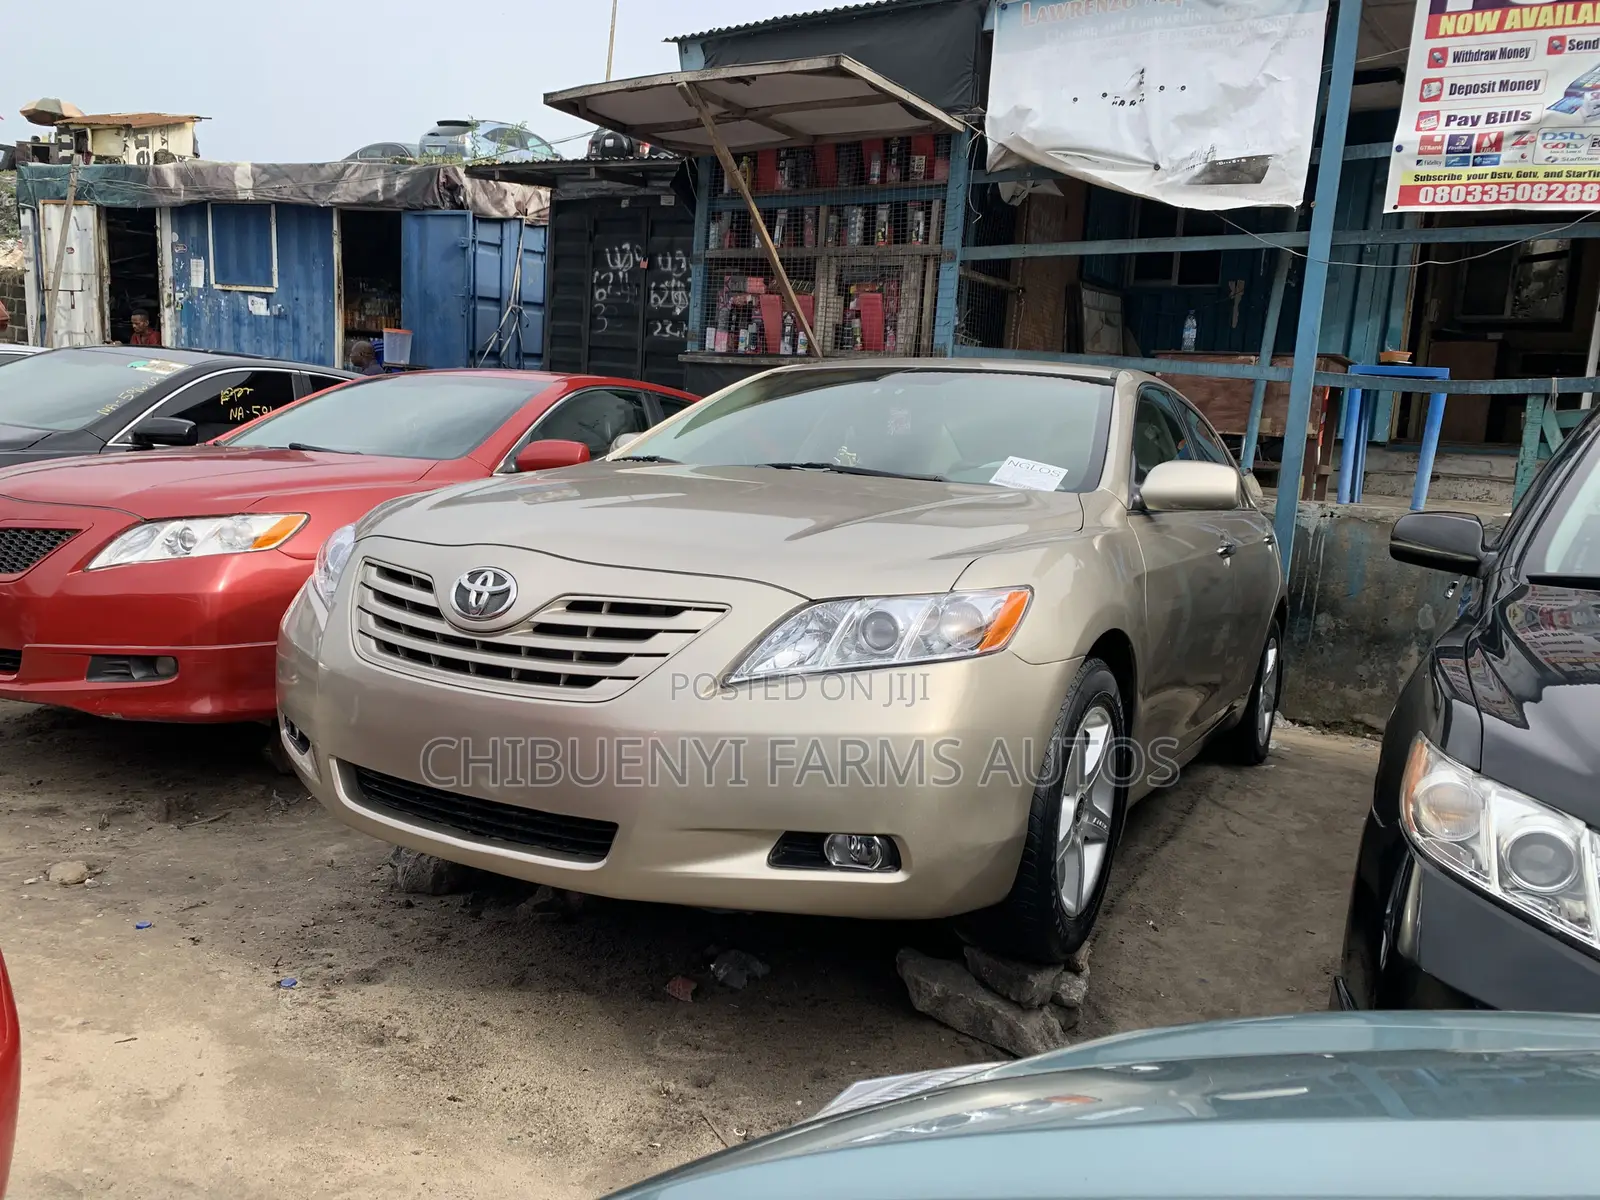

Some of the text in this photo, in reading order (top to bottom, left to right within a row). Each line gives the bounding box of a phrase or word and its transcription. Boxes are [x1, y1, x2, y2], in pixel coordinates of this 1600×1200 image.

[1439, 10, 1502, 36] NOW
[1568, 38, 1600, 51] Send
[1452, 46, 1531, 63] Withdraw Money
[1449, 78, 1541, 96] Deposit Money
[1445, 109, 1532, 128] Pay Bills
[1424, 159, 1442, 167] Fidelity
[1413, 173, 1463, 182] Subscribe
[1466, 173, 1489, 181] your
[1490, 171, 1514, 180] Dstv,
[1516, 170, 1539, 178] Gotv,
[1543, 170, 1564, 178] and
[1419, 182, 1600, 204] 08033508288
[1007, 459, 1061, 478] NGLOS
